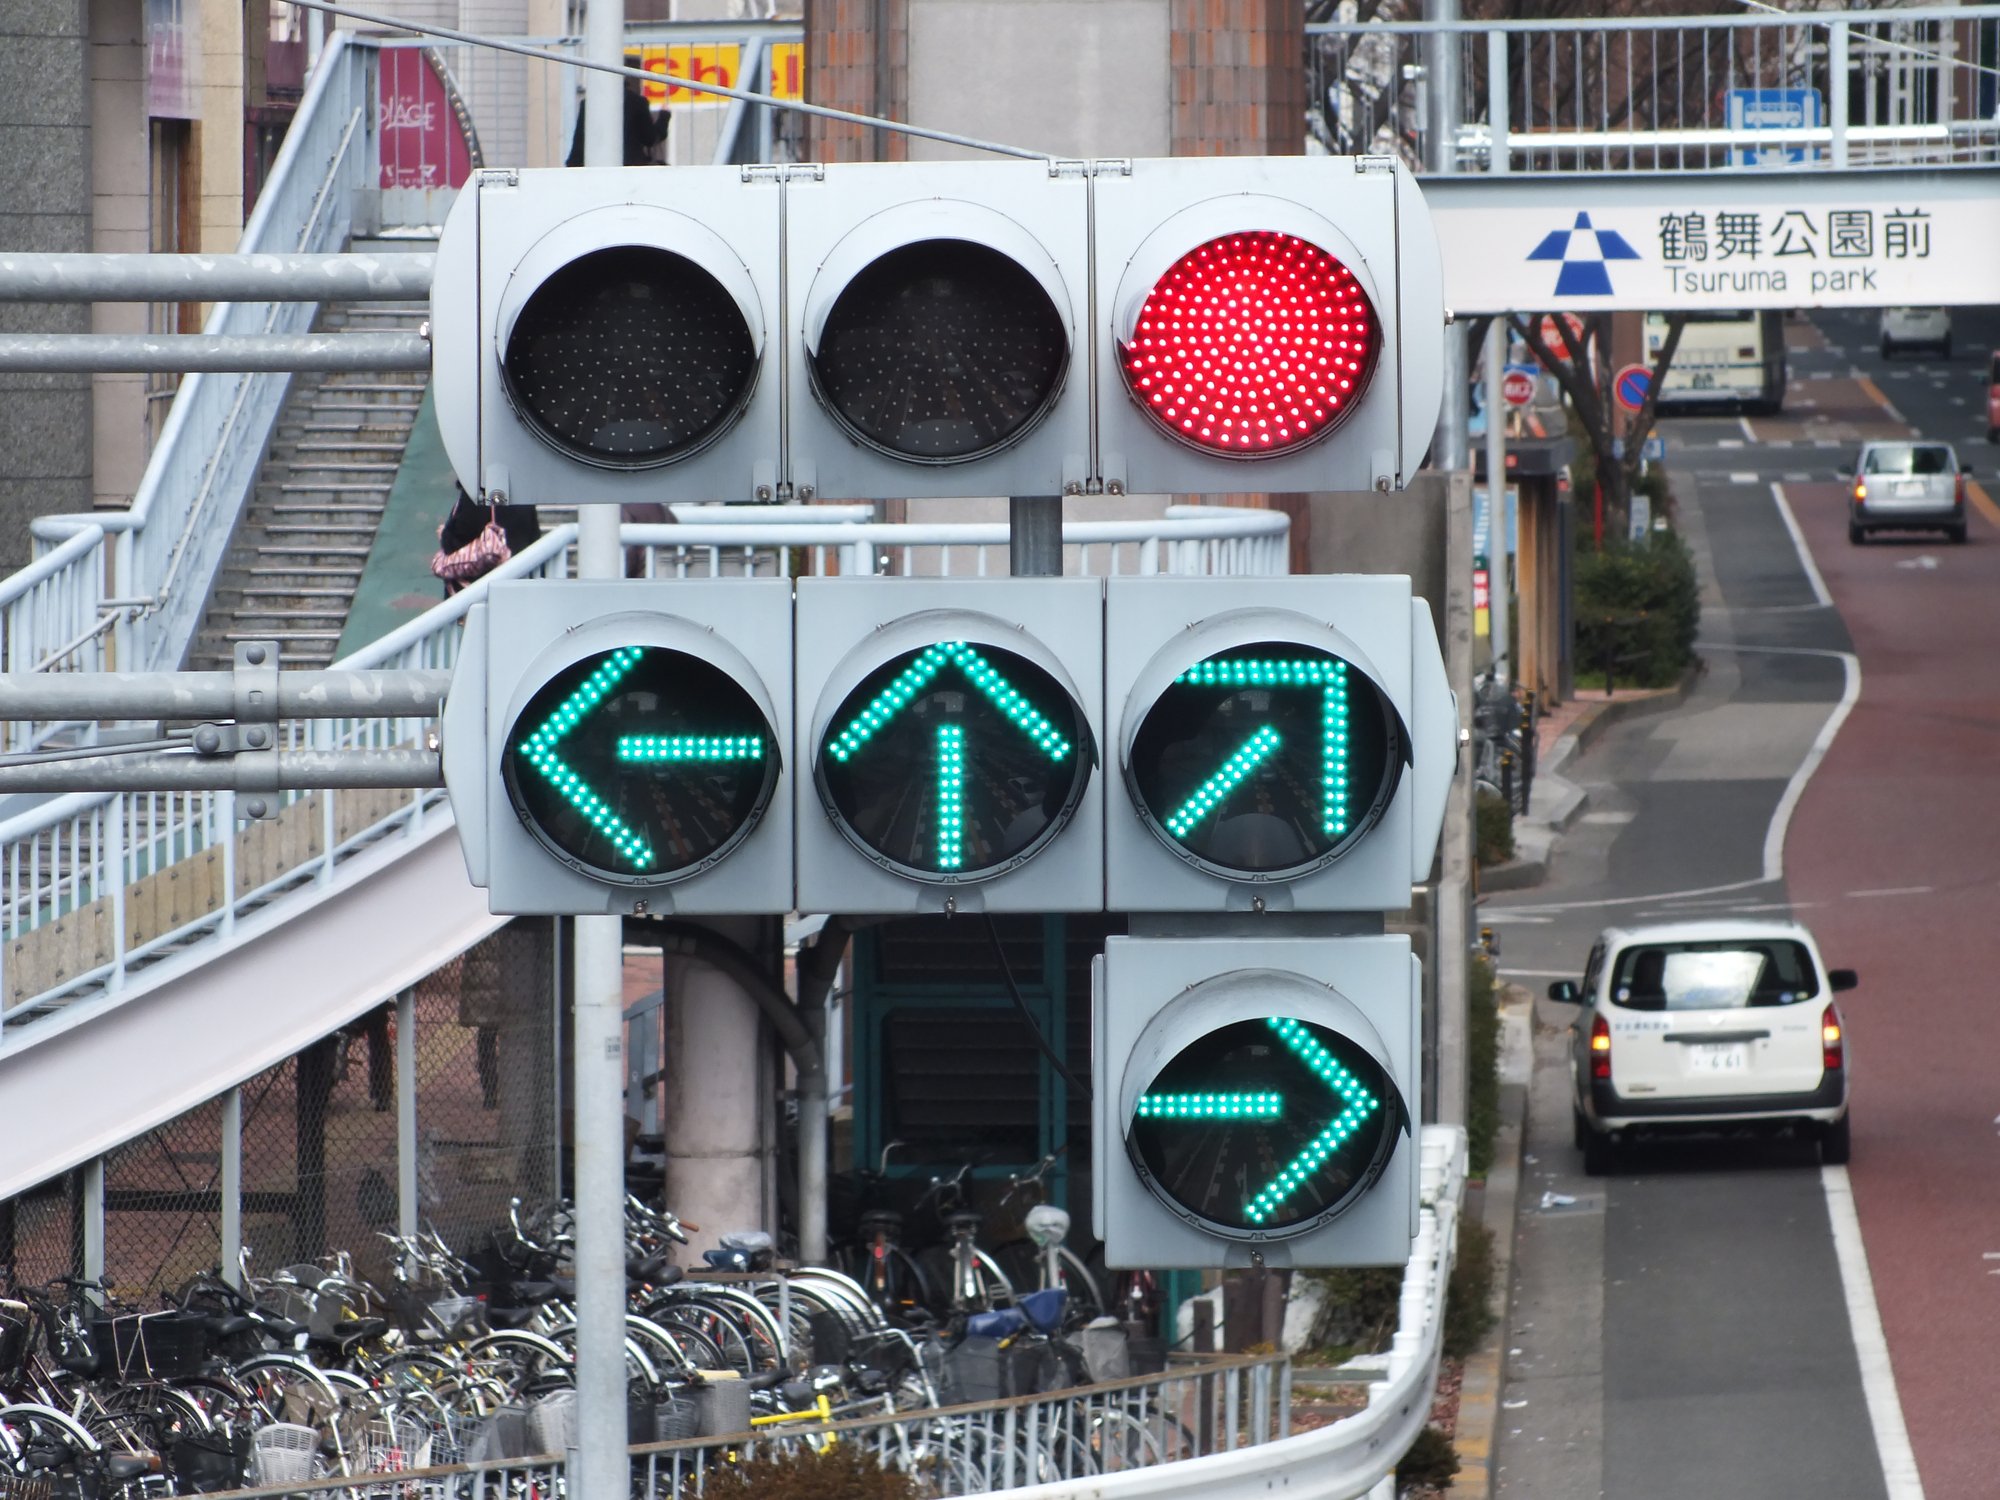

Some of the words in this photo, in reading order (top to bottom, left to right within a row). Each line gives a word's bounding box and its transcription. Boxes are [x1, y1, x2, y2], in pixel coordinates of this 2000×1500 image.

[1659, 207, 1932, 262] 鶴舞公園前
[1663, 265, 1787, 293] Tsuruma
[1811, 265, 1878, 295] park
